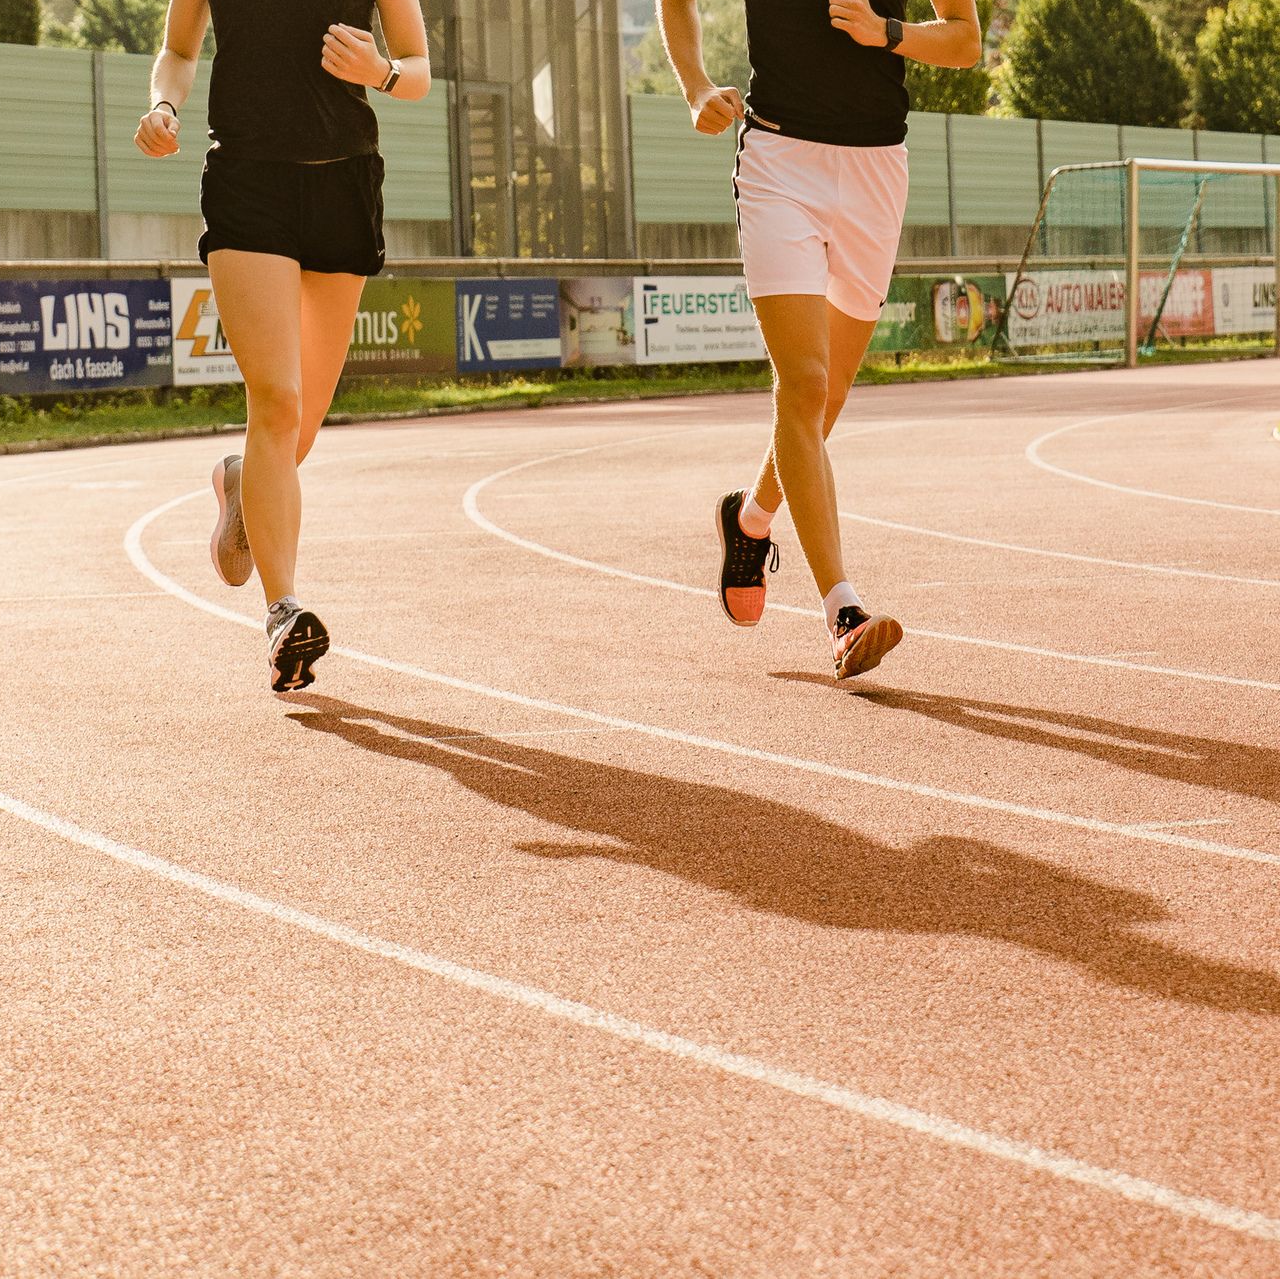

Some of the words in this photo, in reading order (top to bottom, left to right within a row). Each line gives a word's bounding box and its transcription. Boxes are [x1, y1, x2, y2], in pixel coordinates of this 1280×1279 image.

[649, 292, 754, 316] FEUERSTEIN
[39, 292, 131, 351] LINS
[350, 310, 398, 346] mus
[49, 358, 76, 381] dach
[75, 359, 86, 379] &
[85, 356, 124, 379] fassade
